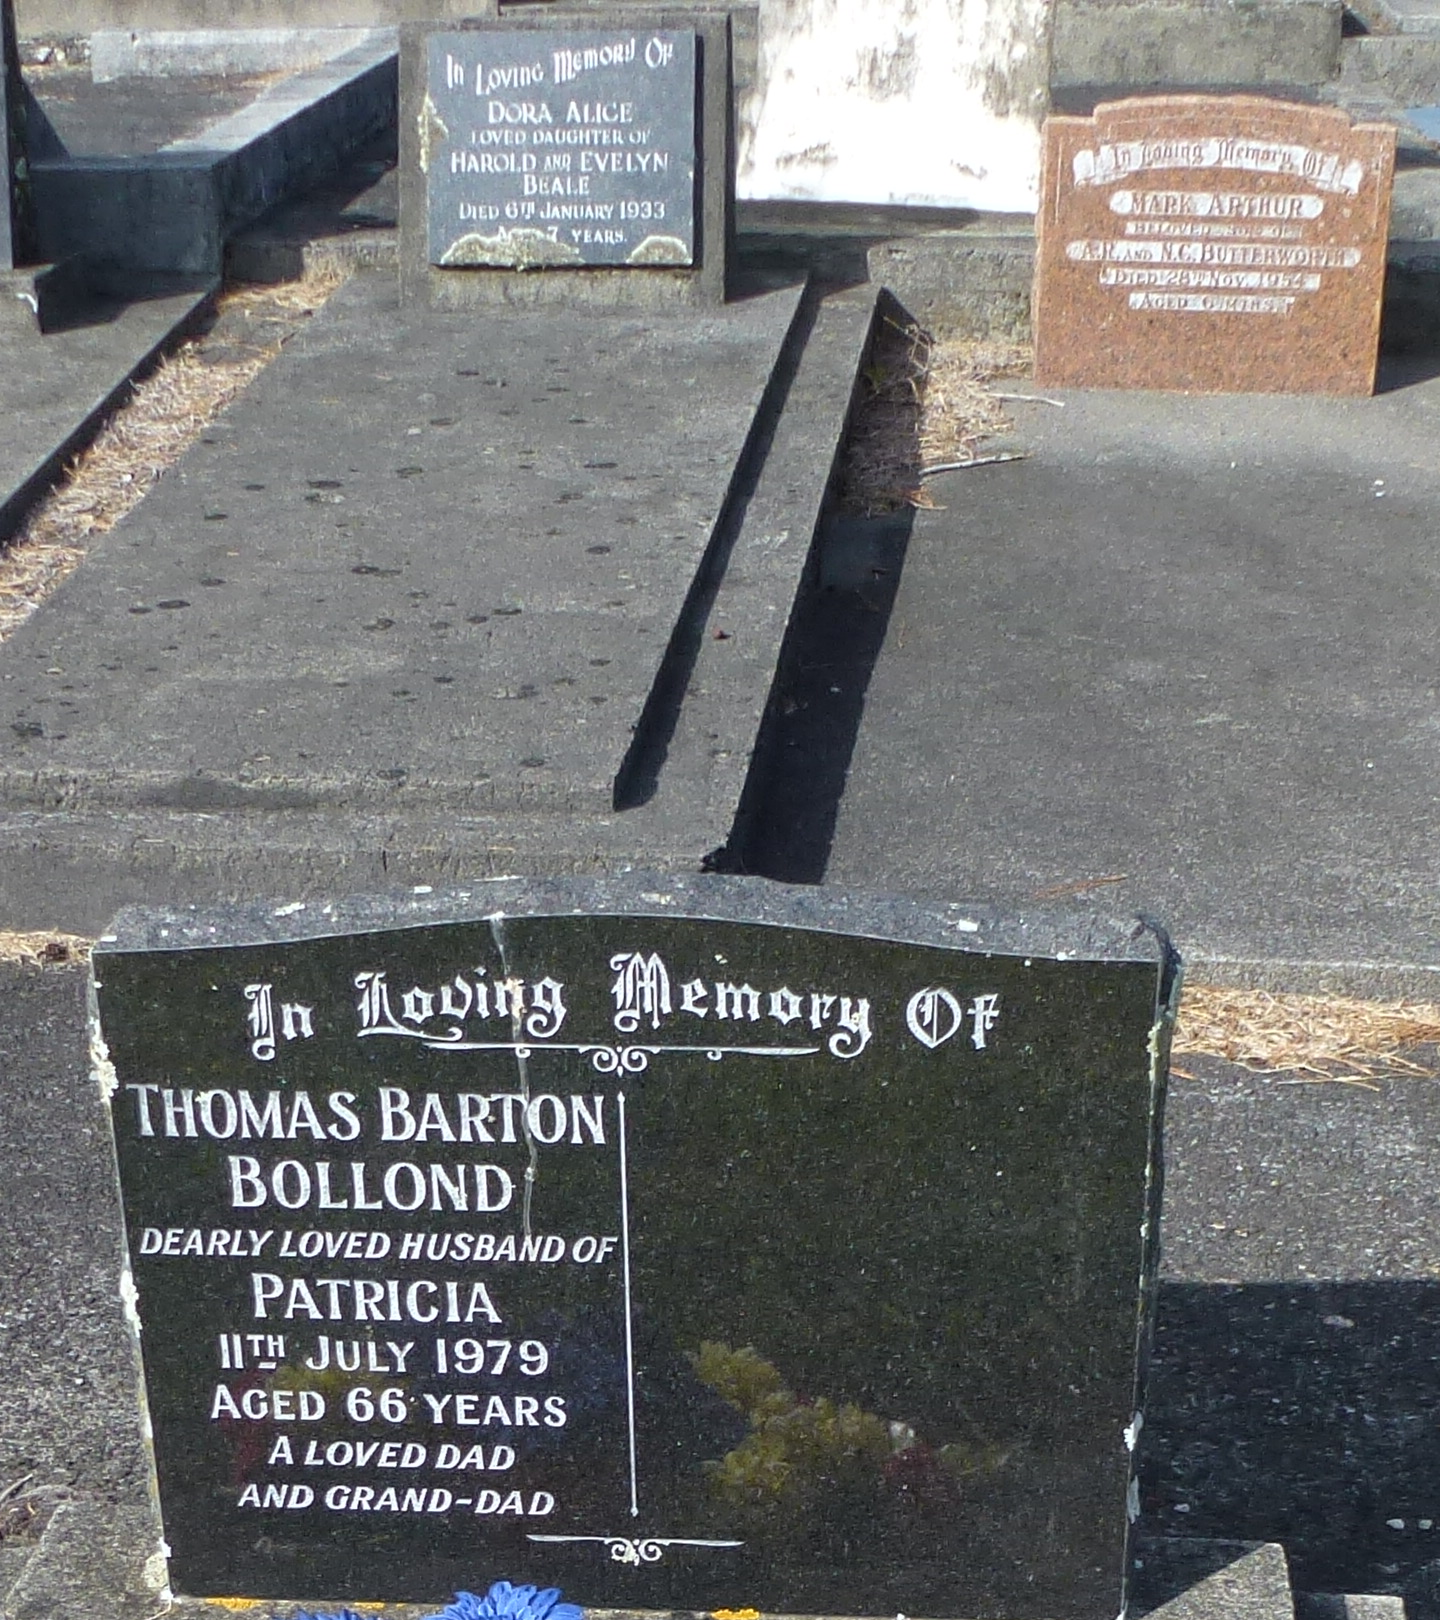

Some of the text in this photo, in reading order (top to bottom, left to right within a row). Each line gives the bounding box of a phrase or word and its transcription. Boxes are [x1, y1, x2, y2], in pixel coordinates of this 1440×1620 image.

[446, 54, 464, 89] In
[475, 62, 545, 96] Loving
[488, 101, 633, 124] DORA ALICE
[471, 129, 652, 145] LOVED DAUGHTER OF
[450, 152, 537, 173] HAROLD
[580, 151, 669, 172] EVELYN
[1113, 147, 1132, 169] In
[523, 174, 591, 195] BEALE
[460, 202, 500, 219] DIED
[540, 201, 613, 219] JANUARY
[620, 200, 665, 219] 1933
[1132, 191, 1305, 220] MARK ARTHUR
[1125, 250, 1152, 261] AND
[1200, 246, 1346, 267] BUTTERWORTH
[1114, 271, 1159, 284] DIED
[1141, 293, 1189, 309] AGED
[244, 950, 998, 1061] In Loving Memory Of
[126, 1083, 606, 1145] THOMAS BARTON
[228, 1155, 514, 1212] BOLLOND
[140, 1227, 618, 1264] DEARLY LOVED HUSBAND OF
[252, 1272, 502, 1324] PATRICIA
[306, 1335, 413, 1373] JULY
[437, 1339, 549, 1376] 1979
[211, 1384, 568, 1427] AGED 66 YEARS
[268, 1436, 516, 1472] A LOVED DAD
[237, 1483, 555, 1516] AND GRAND-DAD
